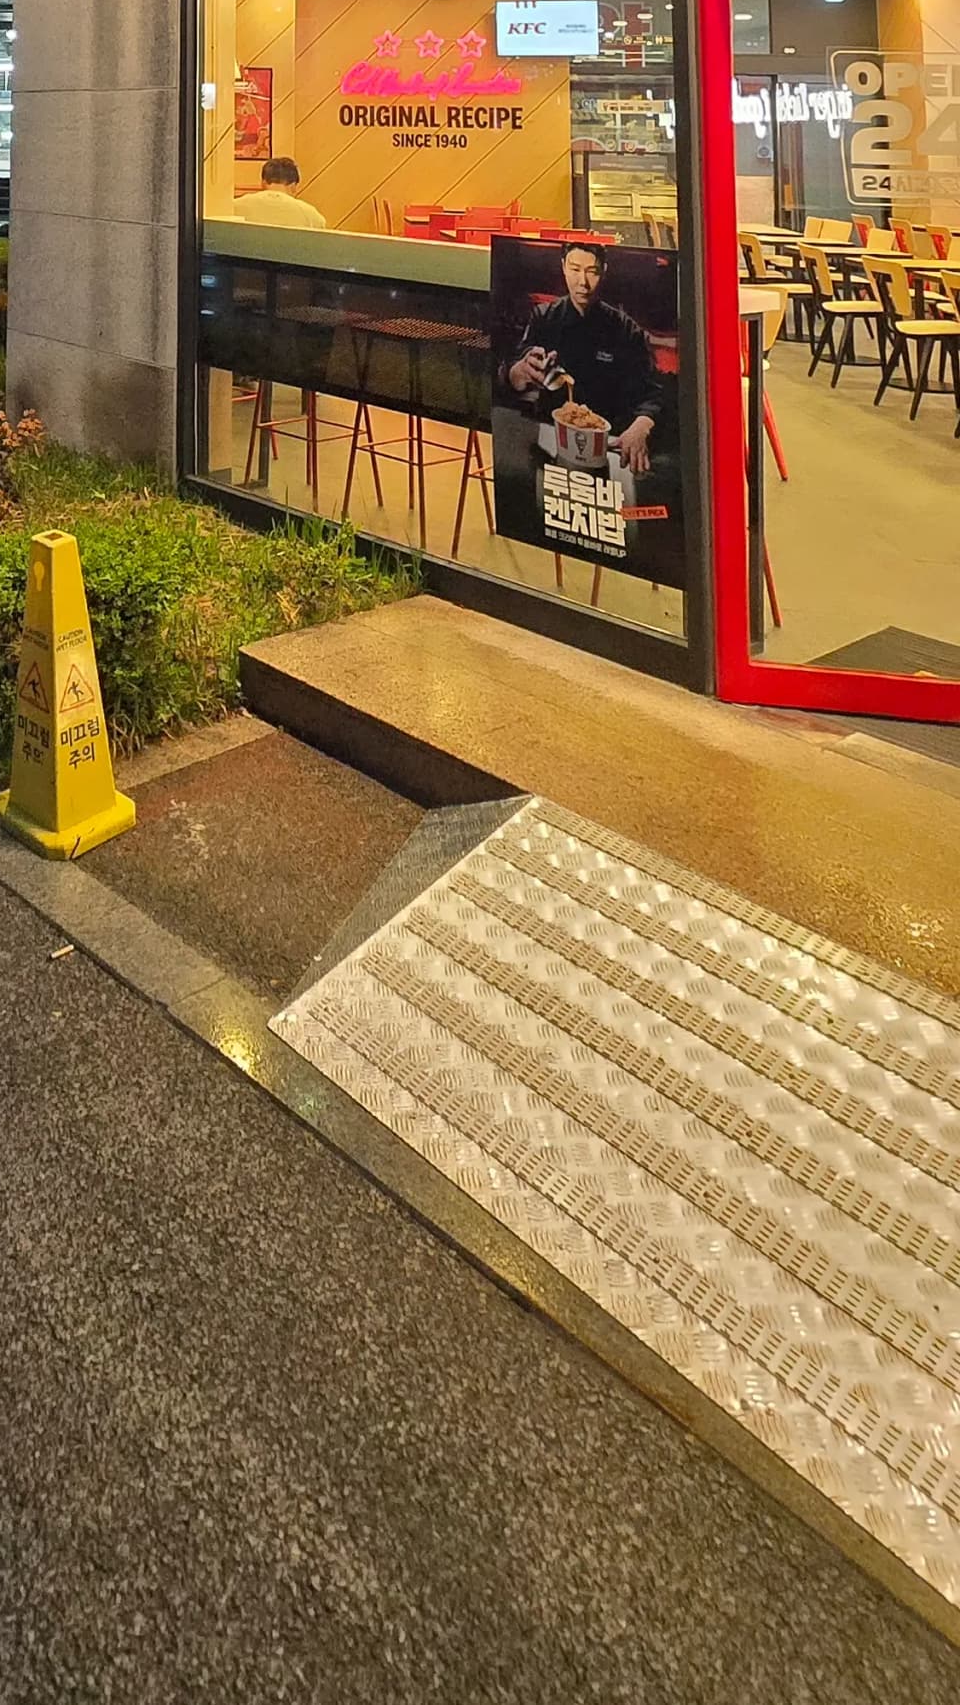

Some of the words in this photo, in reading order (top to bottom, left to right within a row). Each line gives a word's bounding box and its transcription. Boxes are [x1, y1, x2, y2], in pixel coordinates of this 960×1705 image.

[507, 22, 547, 35] KFC
[339, 104, 440, 128] ORIGINAL
[446, 106, 524, 129] RECIPE
[392, 133, 431, 148] SINCE
[435, 134, 468, 149] 1940
[543, 463, 625, 512] 투움바
[543, 495, 627, 547] 켄치밥
[59, 716, 101, 747] 미끄럼
[68, 742, 97, 770] 주의
